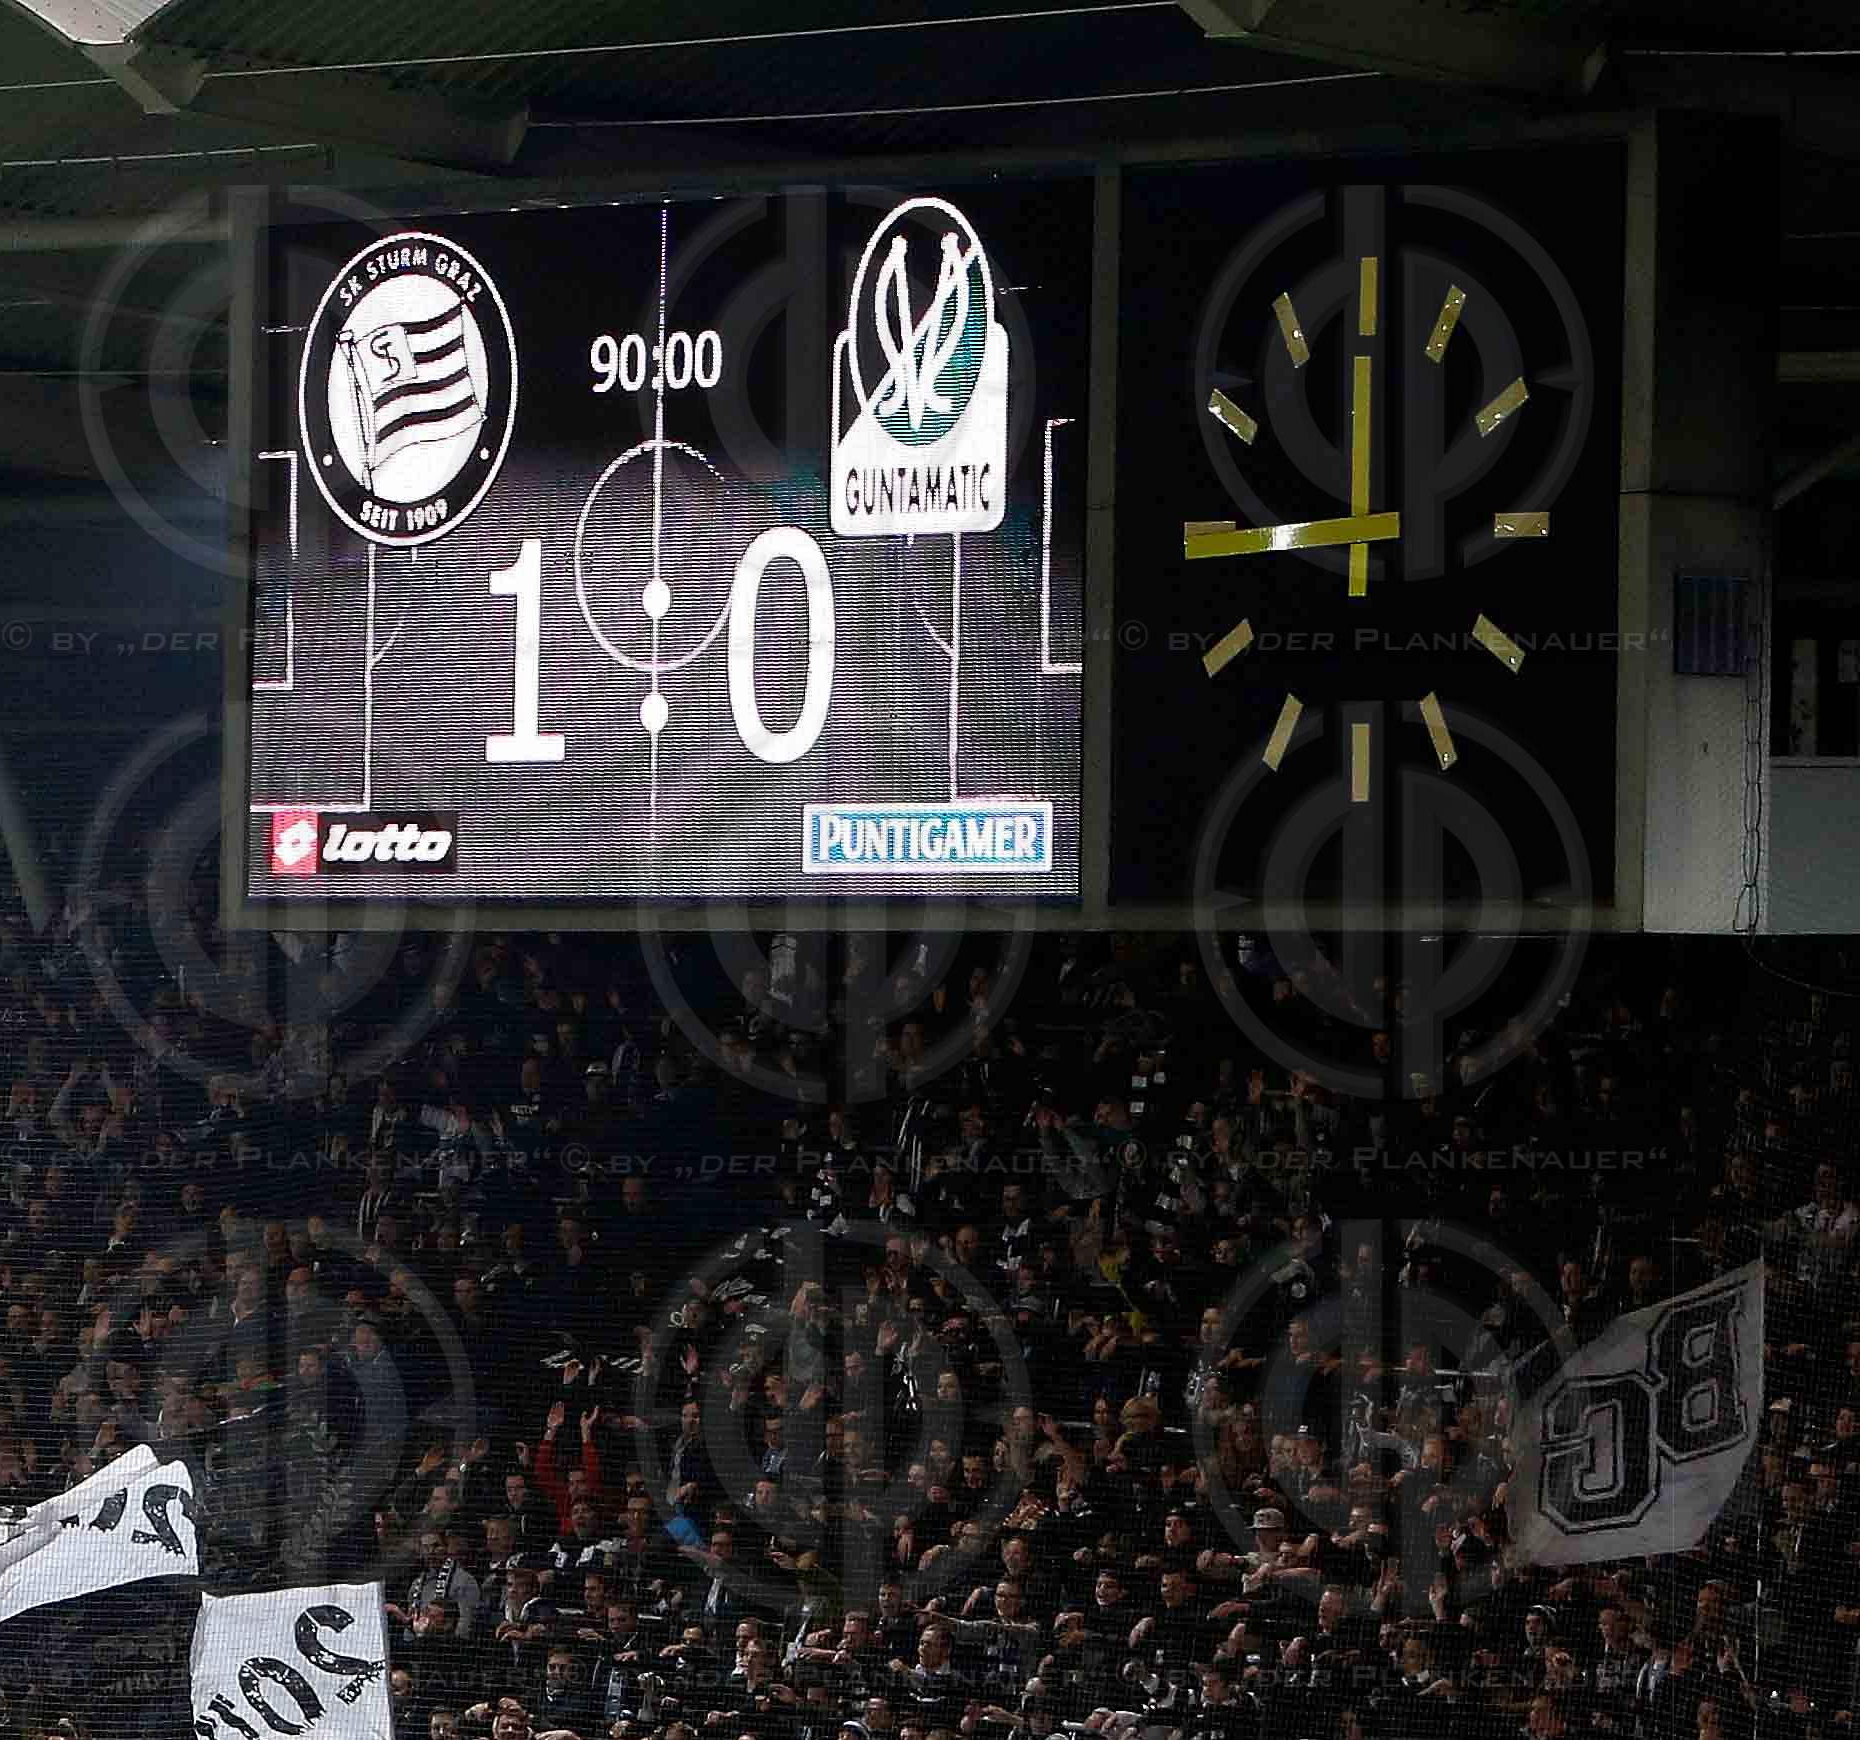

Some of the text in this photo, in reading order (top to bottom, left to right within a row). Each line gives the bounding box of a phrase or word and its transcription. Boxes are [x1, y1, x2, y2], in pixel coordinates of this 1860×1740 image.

[340, 246, 482, 307] SK STURM GRAZ
[590, 331, 722, 393] 90:00
[360, 498, 449, 531] SEIT 1909
[844, 463, 995, 517] GUNTAMATIC
[486, 526, 837, 764] 1 0
[322, 822, 454, 864] lotto
[817, 812, 1038, 862] PUNTIGAMER
